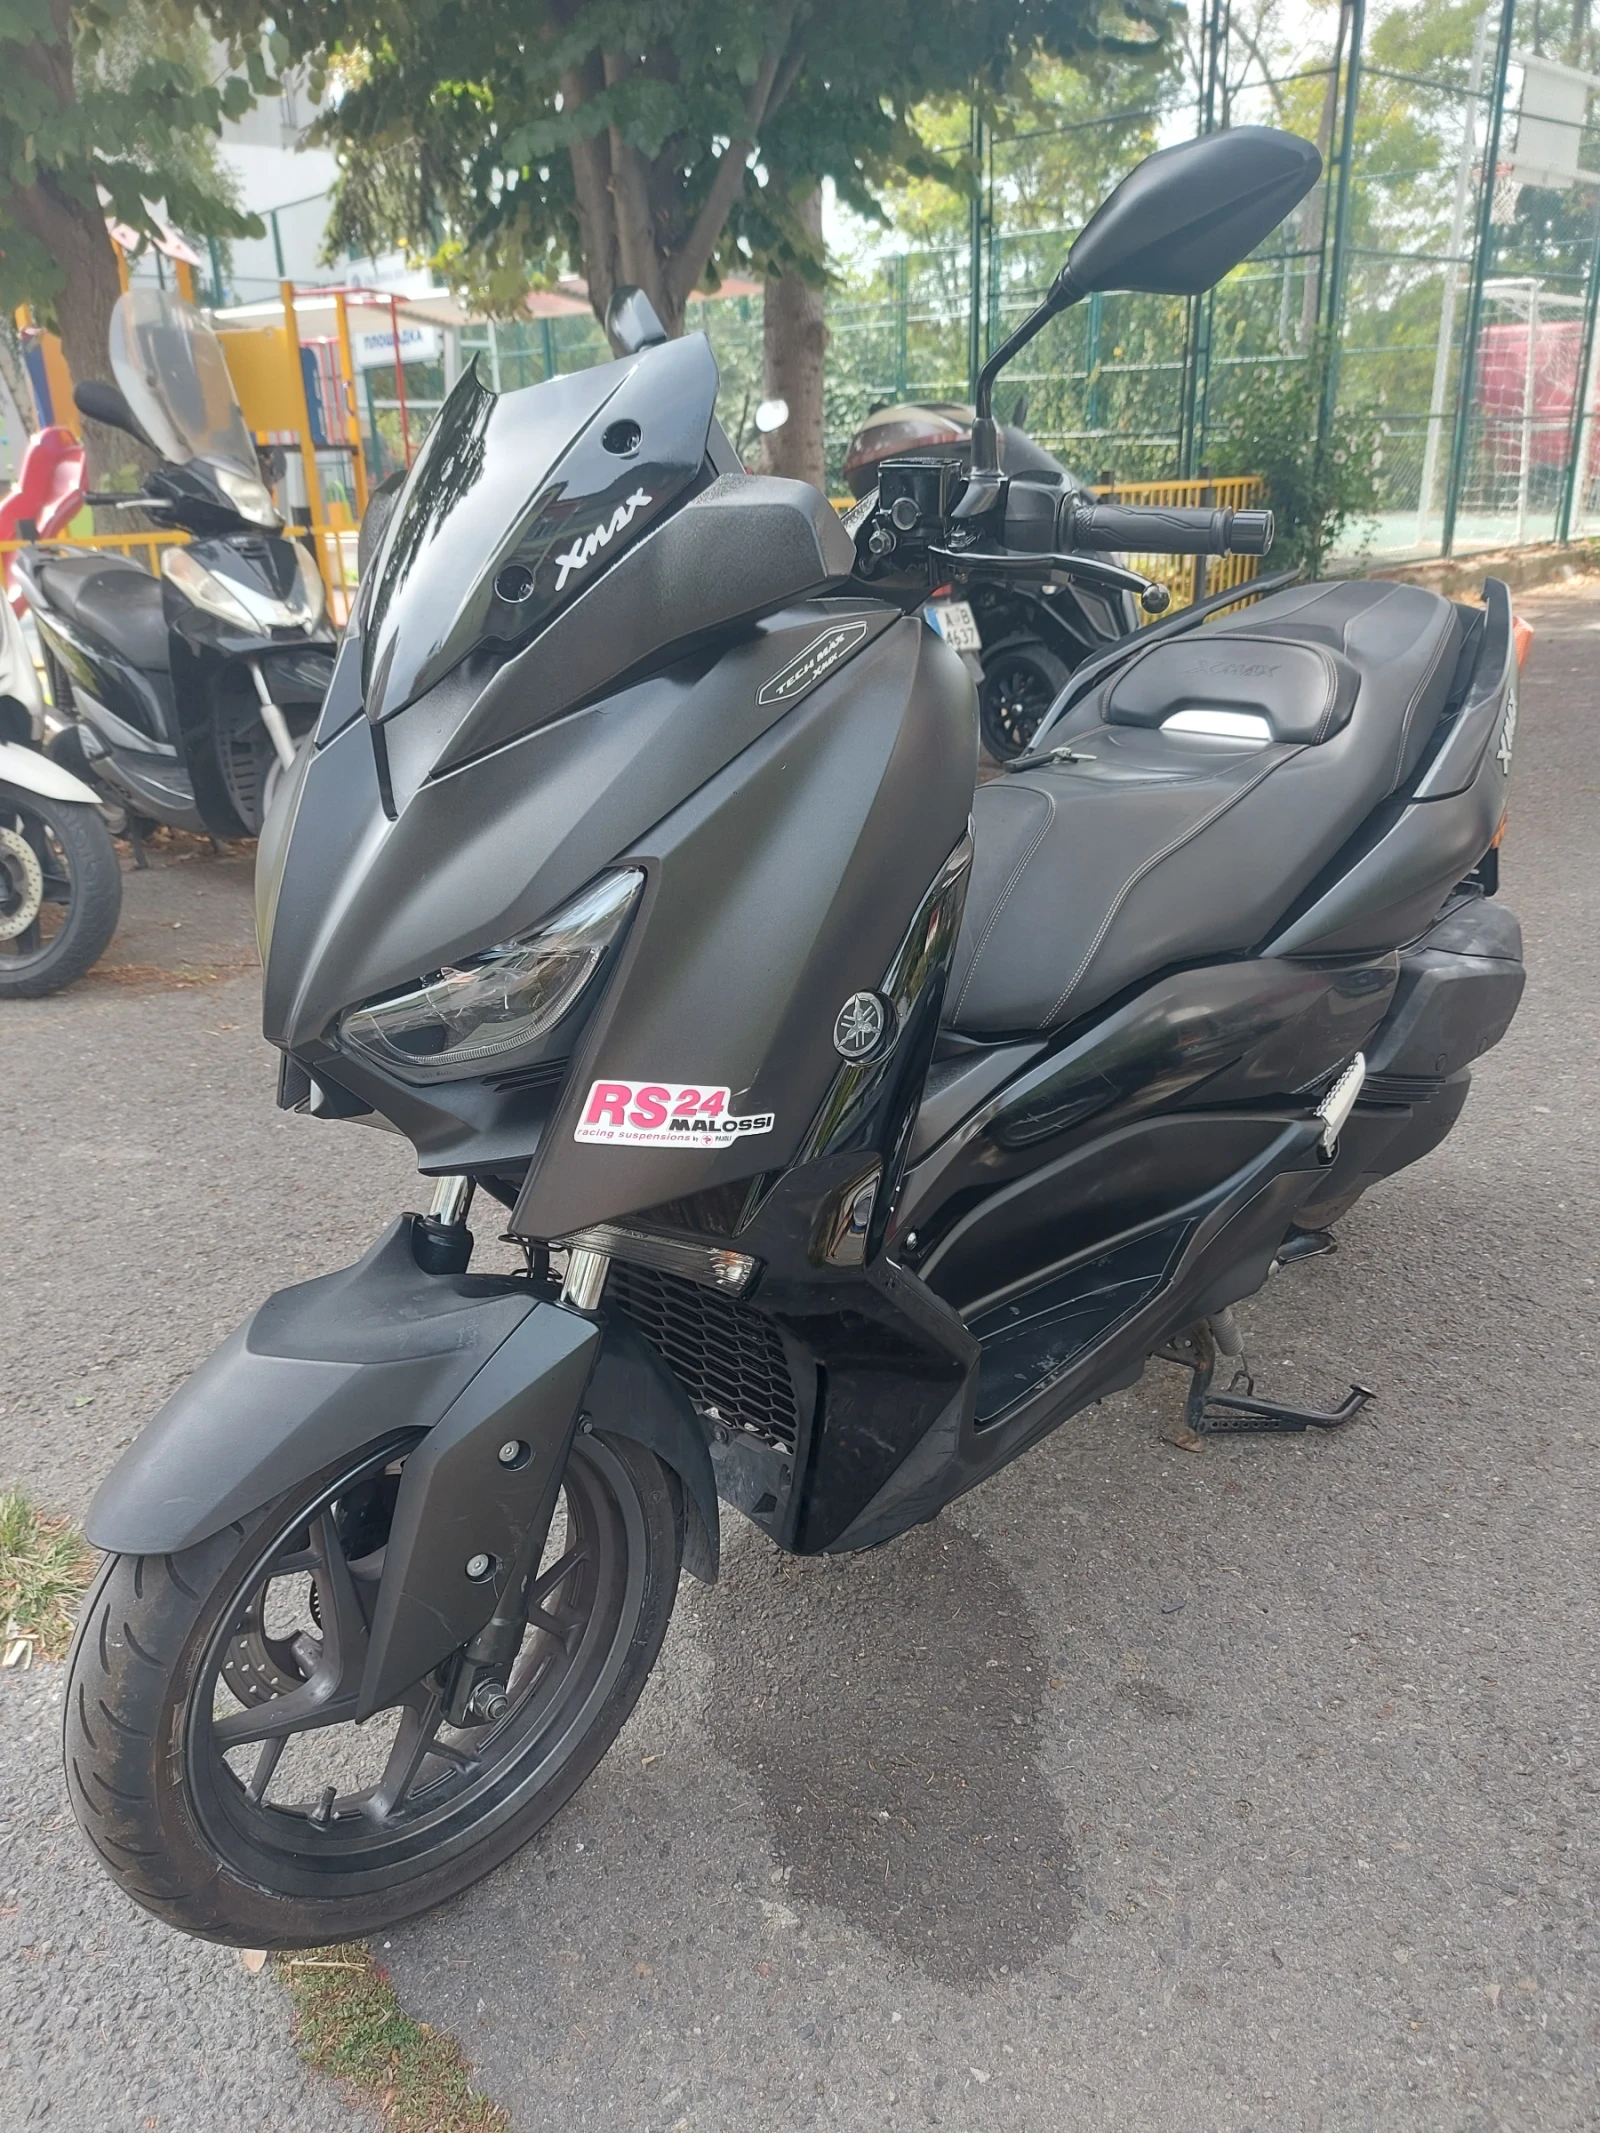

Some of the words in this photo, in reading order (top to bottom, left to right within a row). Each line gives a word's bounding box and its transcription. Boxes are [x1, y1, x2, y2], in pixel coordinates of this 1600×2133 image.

[363, 330, 423, 349] ПЛОЩДКА
[555, 487, 653, 591] XMAX
[776, 658, 815, 694] TECH
[669, 1116, 773, 1132] MALOSSI
[577, 1128, 614, 1139] racing
[618, 1131, 690, 1141] suspensions
